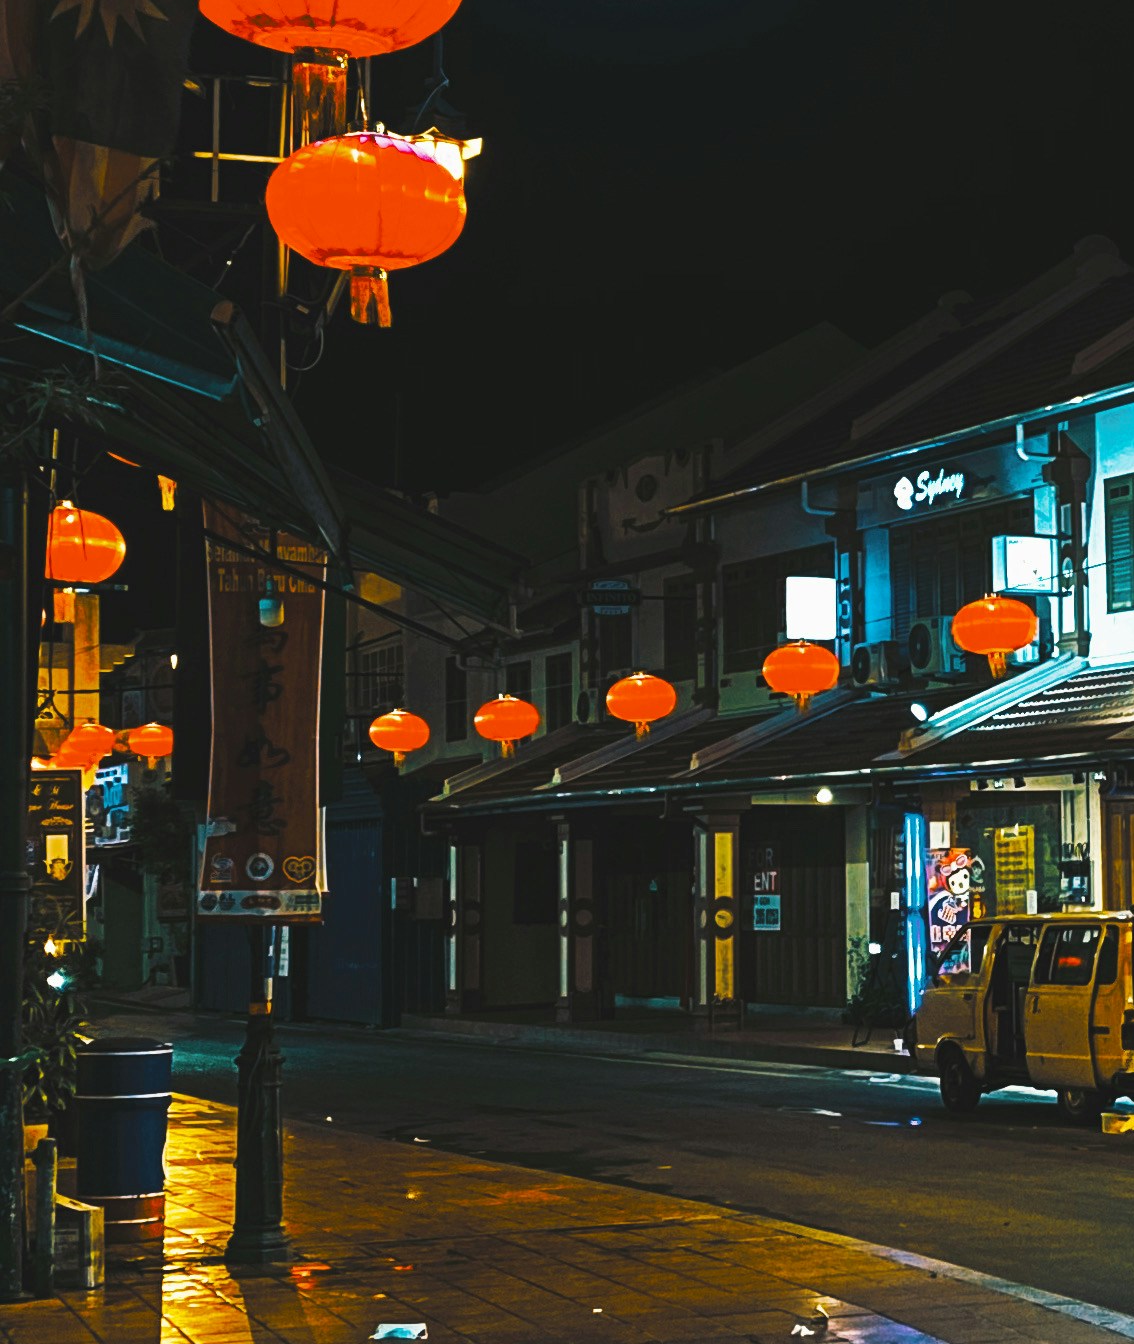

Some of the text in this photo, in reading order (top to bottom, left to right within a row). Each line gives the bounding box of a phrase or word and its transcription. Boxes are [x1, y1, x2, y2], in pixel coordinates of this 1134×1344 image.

[915, 468, 964, 505] Sydney
[257, 568, 285, 592] Bru
[753, 871, 777, 890] ENT
